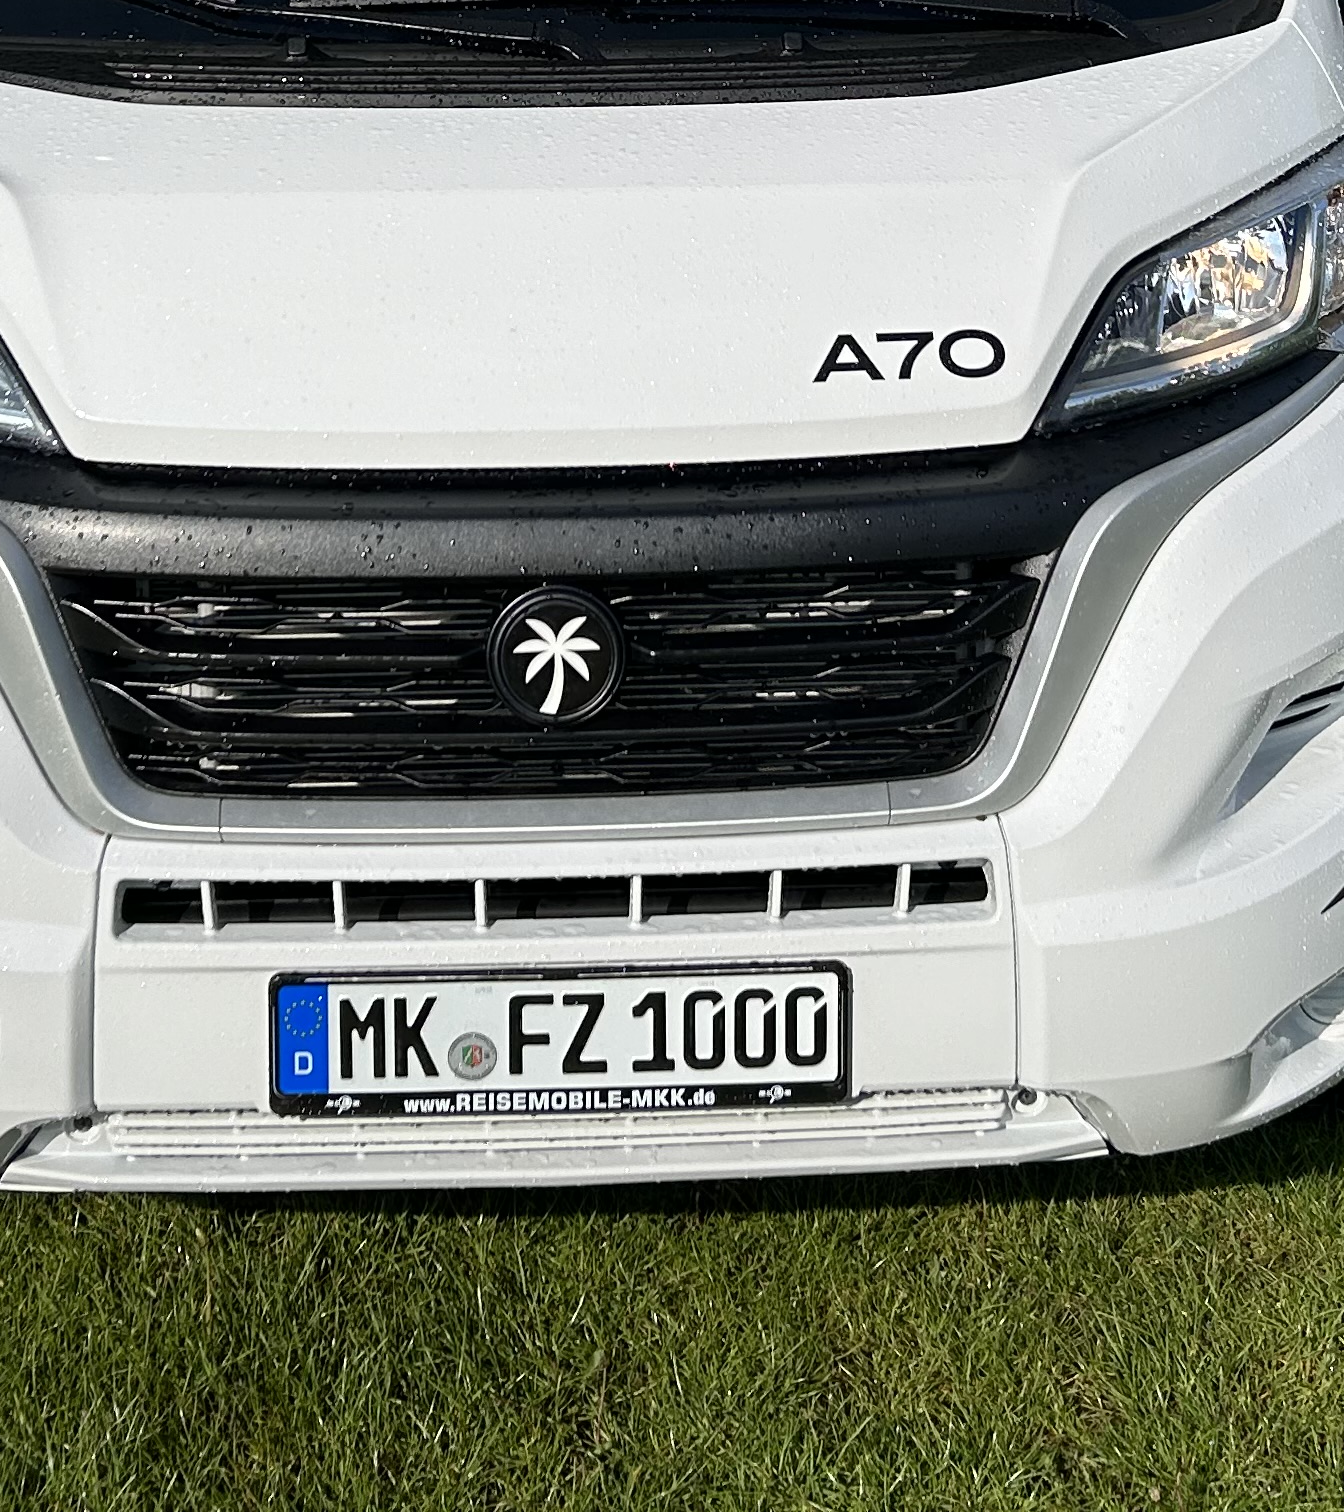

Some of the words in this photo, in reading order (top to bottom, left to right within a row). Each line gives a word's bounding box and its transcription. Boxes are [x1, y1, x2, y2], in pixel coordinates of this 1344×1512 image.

[812, 328, 1006, 383] A70
[338, 995, 439, 1080] MK
[508, 991, 609, 1076] FZ
[630, 986, 828, 1072] 1000
[294, 1051, 314, 1076] D
[403, 1087, 716, 1114] www.REISEMOBILE-MKK.de
